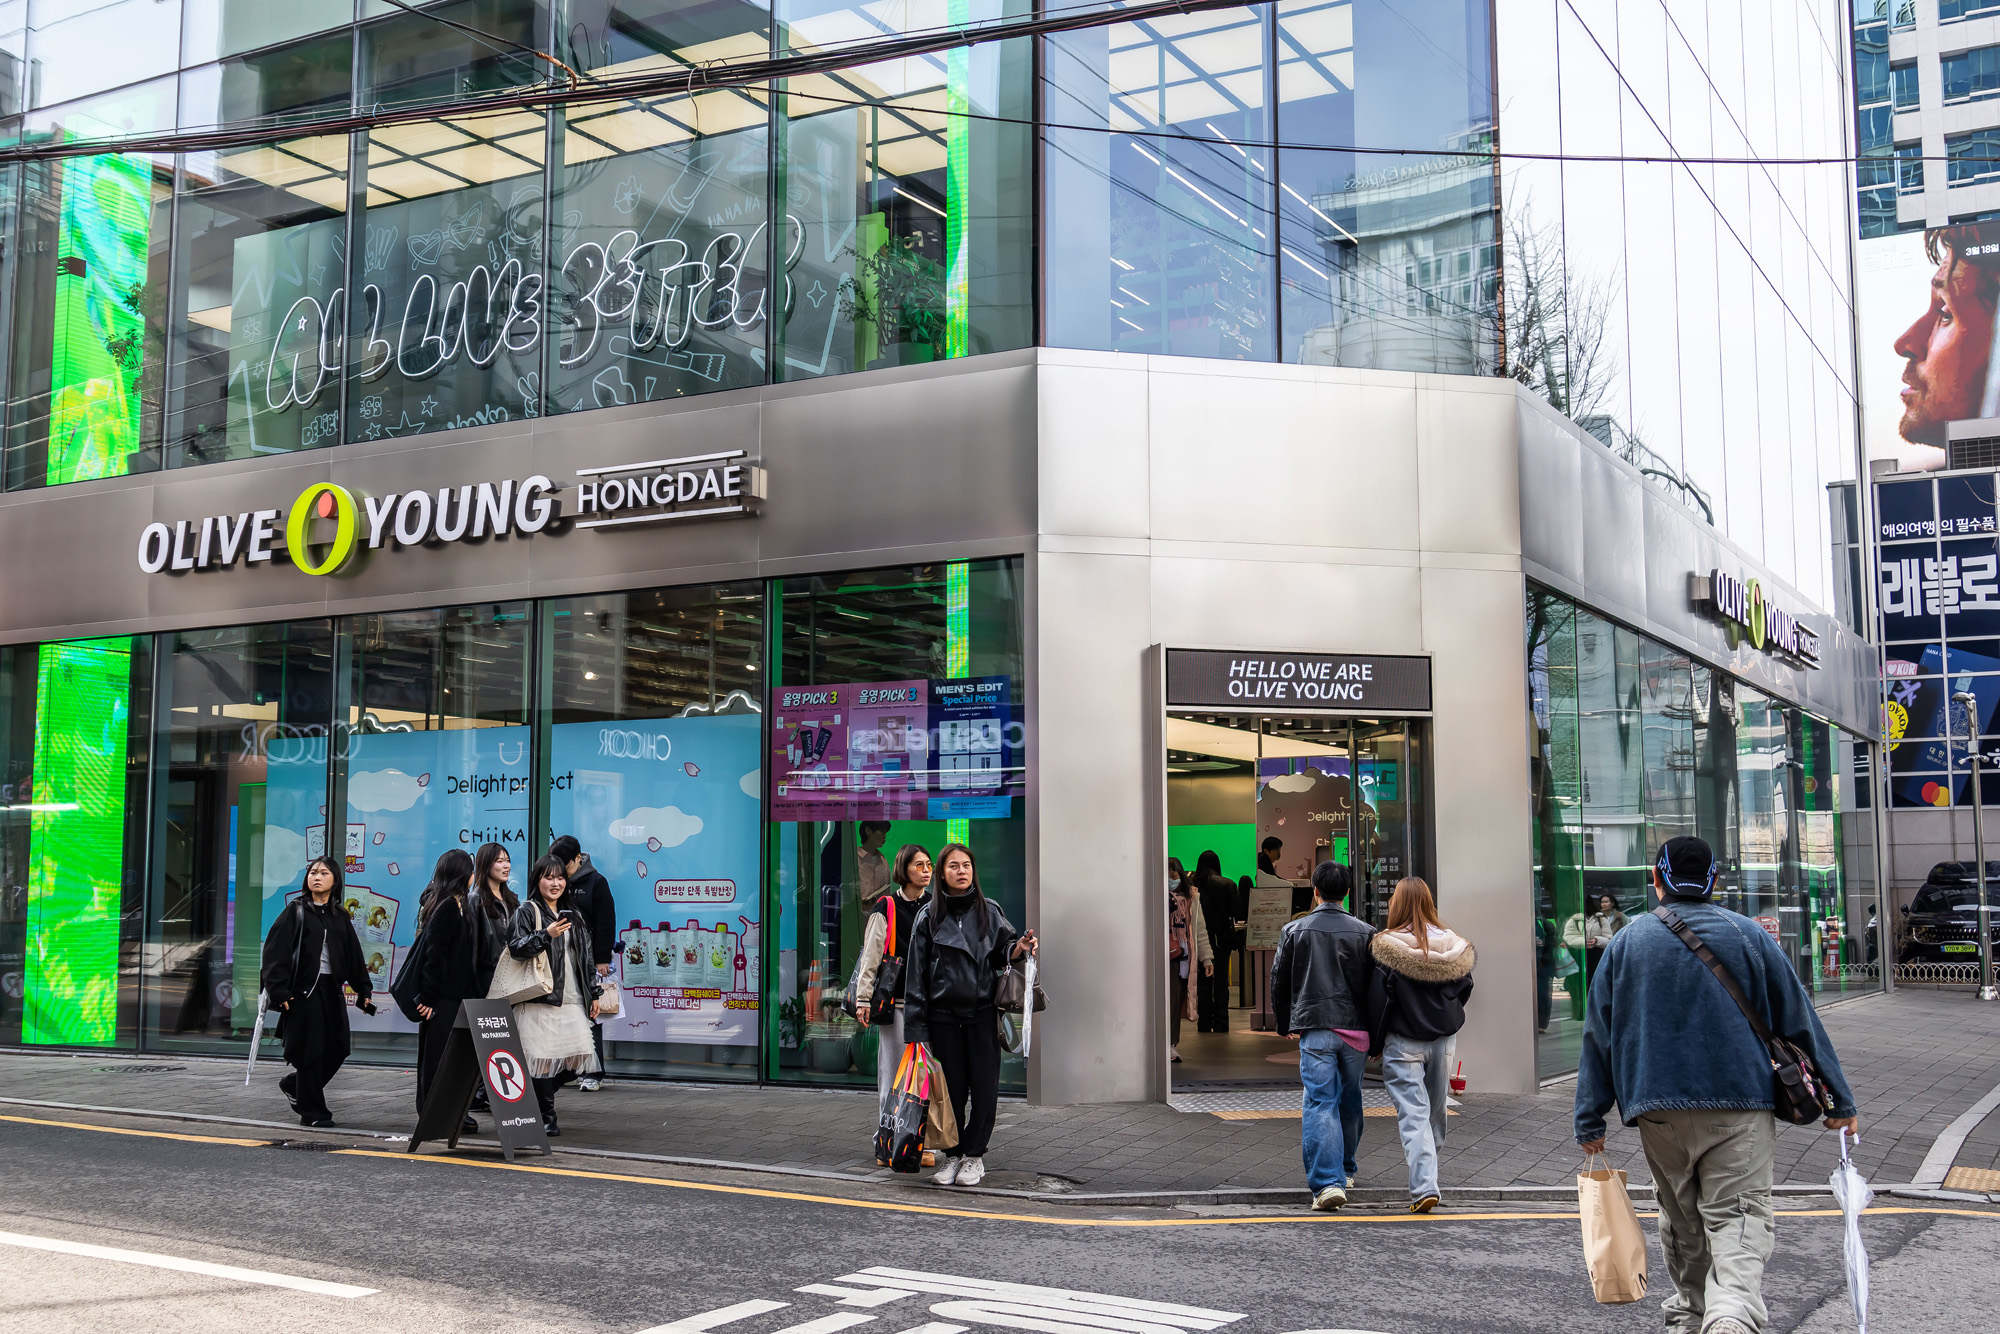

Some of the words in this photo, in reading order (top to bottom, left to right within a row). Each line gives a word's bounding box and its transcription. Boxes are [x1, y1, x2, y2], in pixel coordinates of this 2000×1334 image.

[1965, 246, 1980, 257] 3월
[1981, 243, 1999, 255] 18일
[137, 509, 280, 575] OLIVE
[363, 475, 557, 550] YOUNG
[577, 465, 742, 514] HONGDAE
[1882, 519, 1954, 538] 해외여행의
[1956, 516, 1996, 533] 필수품
[1877, 554, 2000, 618] 래블로
[1716, 567, 1750, 627] OLIVE
[1764, 600, 1797, 655] YOUNG
[1229, 660, 1296, 679] HELLO
[1299, 661, 1332, 680] WE
[1334, 663, 1373, 681] ARE
[1897, 663, 1916, 676] KOR
[858, 689, 879, 704] 올영
[879, 688, 906, 702] PICK
[908, 687, 917, 701] 3
[935, 684, 975, 695] MEN'S
[976, 682, 1003, 692] EDIT
[1228, 679, 1288, 699] OLIVE
[1292, 681, 1363, 700] YOUNG
[782, 692, 802, 707] 올영
[802, 692, 828, 706] PICK
[829, 691, 838, 704] 3
[942, 694, 973, 706] Special
[975, 693, 997, 703] Price
[447, 773, 507, 798] Delight
[509, 770, 574, 796] prect
[1308, 811, 1345, 824] Delight
[459, 827, 556, 844] CHiiKAA
[657, 885, 685, 897] 올리브영
[687, 885, 702, 896] 단독
[704, 885, 732, 897] 특별한정
[477, 1016, 508, 1029] 주차금지
[520, 1117, 536, 1125] YOUNG
